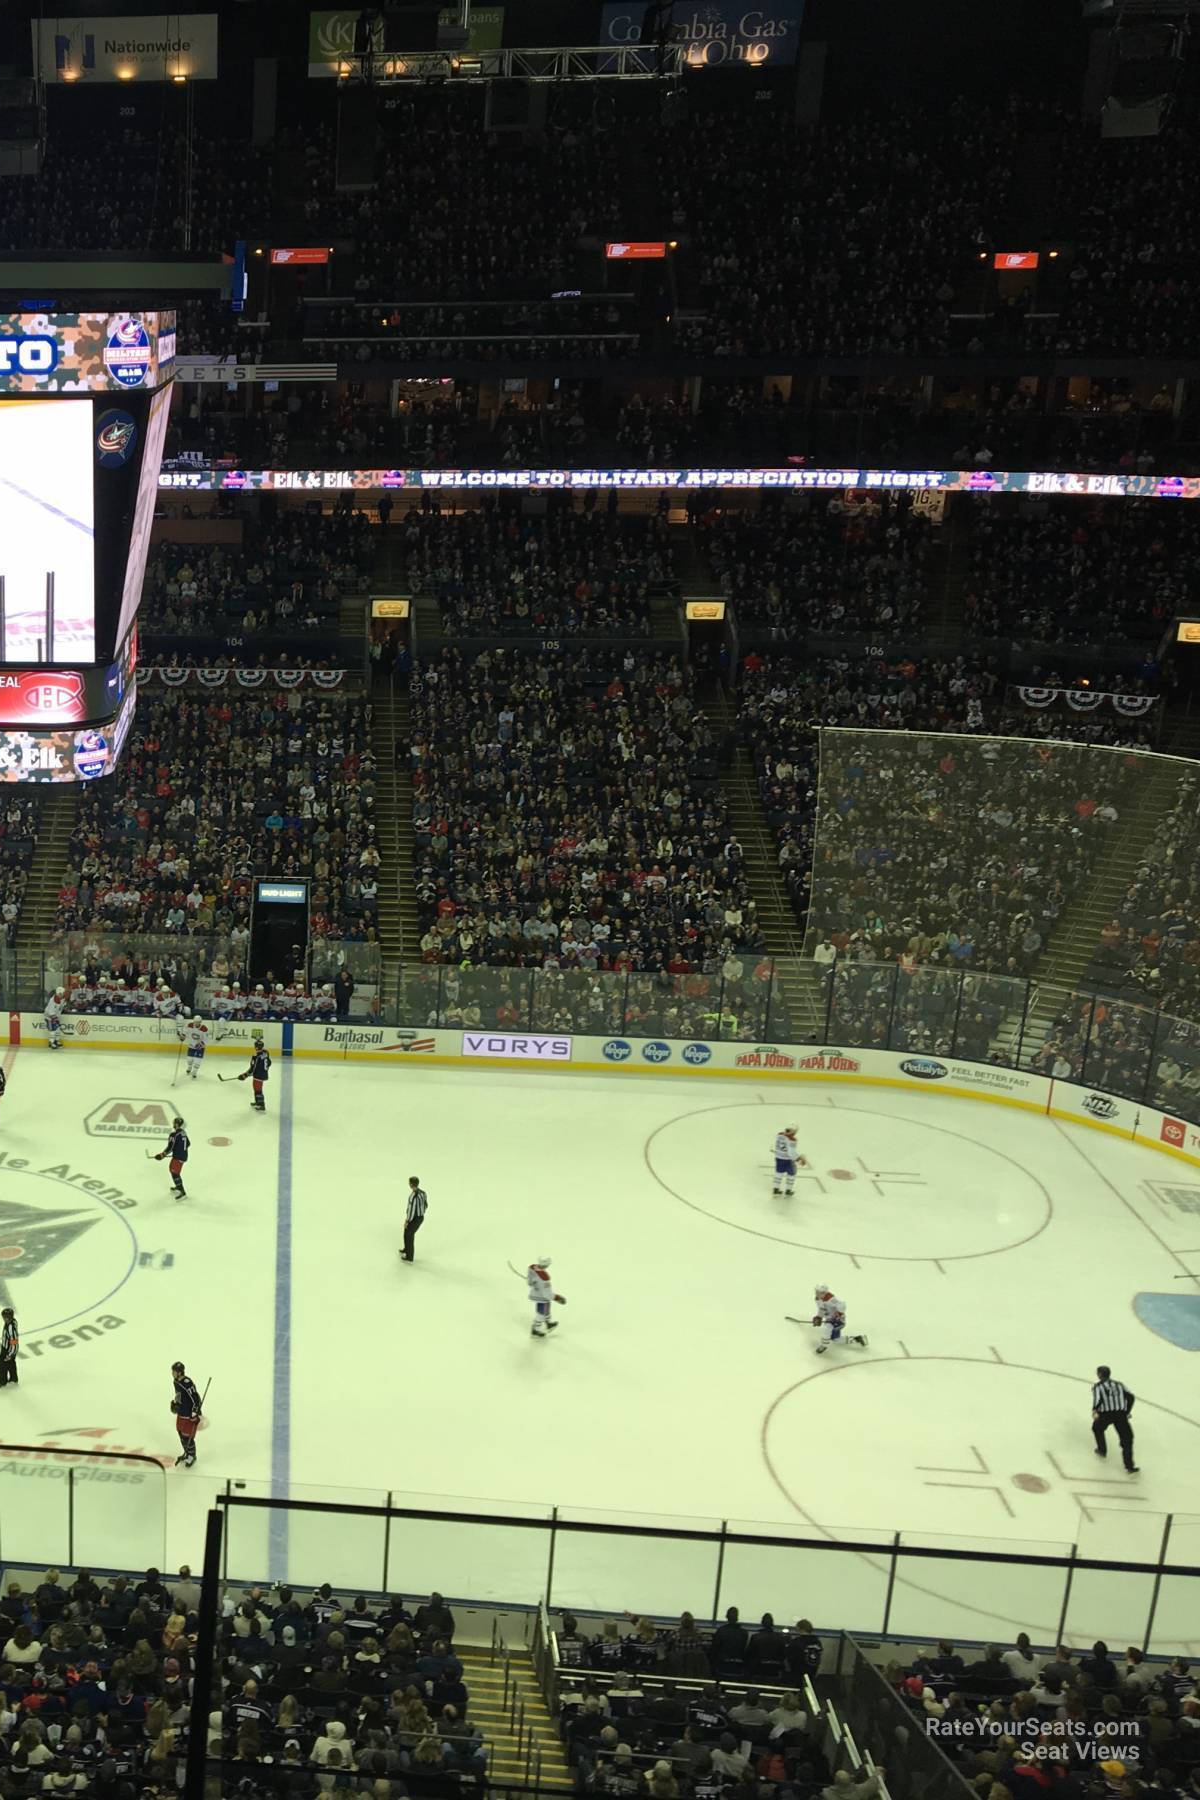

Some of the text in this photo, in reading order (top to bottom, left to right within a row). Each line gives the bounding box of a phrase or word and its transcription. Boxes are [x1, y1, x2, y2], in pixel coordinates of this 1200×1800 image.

[740, 11, 789, 38] Gas
[104, 40, 192, 54] Nationwide
[702, 35, 769, 65] Ohio
[159, 473, 201, 486] GHT
[274, 471, 353, 488] Elk & Elk
[420, 472, 943, 486] WELCOME TO MILITARY APPRECIATION NIGHT
[1028, 472, 1126, 495] Elk & Elk
[542, 641, 560, 650] 105
[865, 646, 884, 656] 106
[21, 745, 64, 769] Elk
[280, 890, 303, 898] LIGHT
[92, 1024, 143, 1034] SECURITY
[324, 1027, 384, 1044] Barbasol
[466, 1037, 569, 1056] VORYS
[605, 1043, 630, 1060] Kroger
[645, 1045, 670, 1062] Kroger
[685, 1046, 710, 1063] Kroger
[736, 1053, 761, 1067] PAPA
[800, 1056, 825, 1071] PAPA
[903, 1062, 947, 1077] Pedialyte
[951, 1067, 972, 1076] FEEL
[974, 1070, 1007, 1082] BETTER
[1009, 1075, 1031, 1088] FAST
[40, 1162, 139, 1212] Arena
